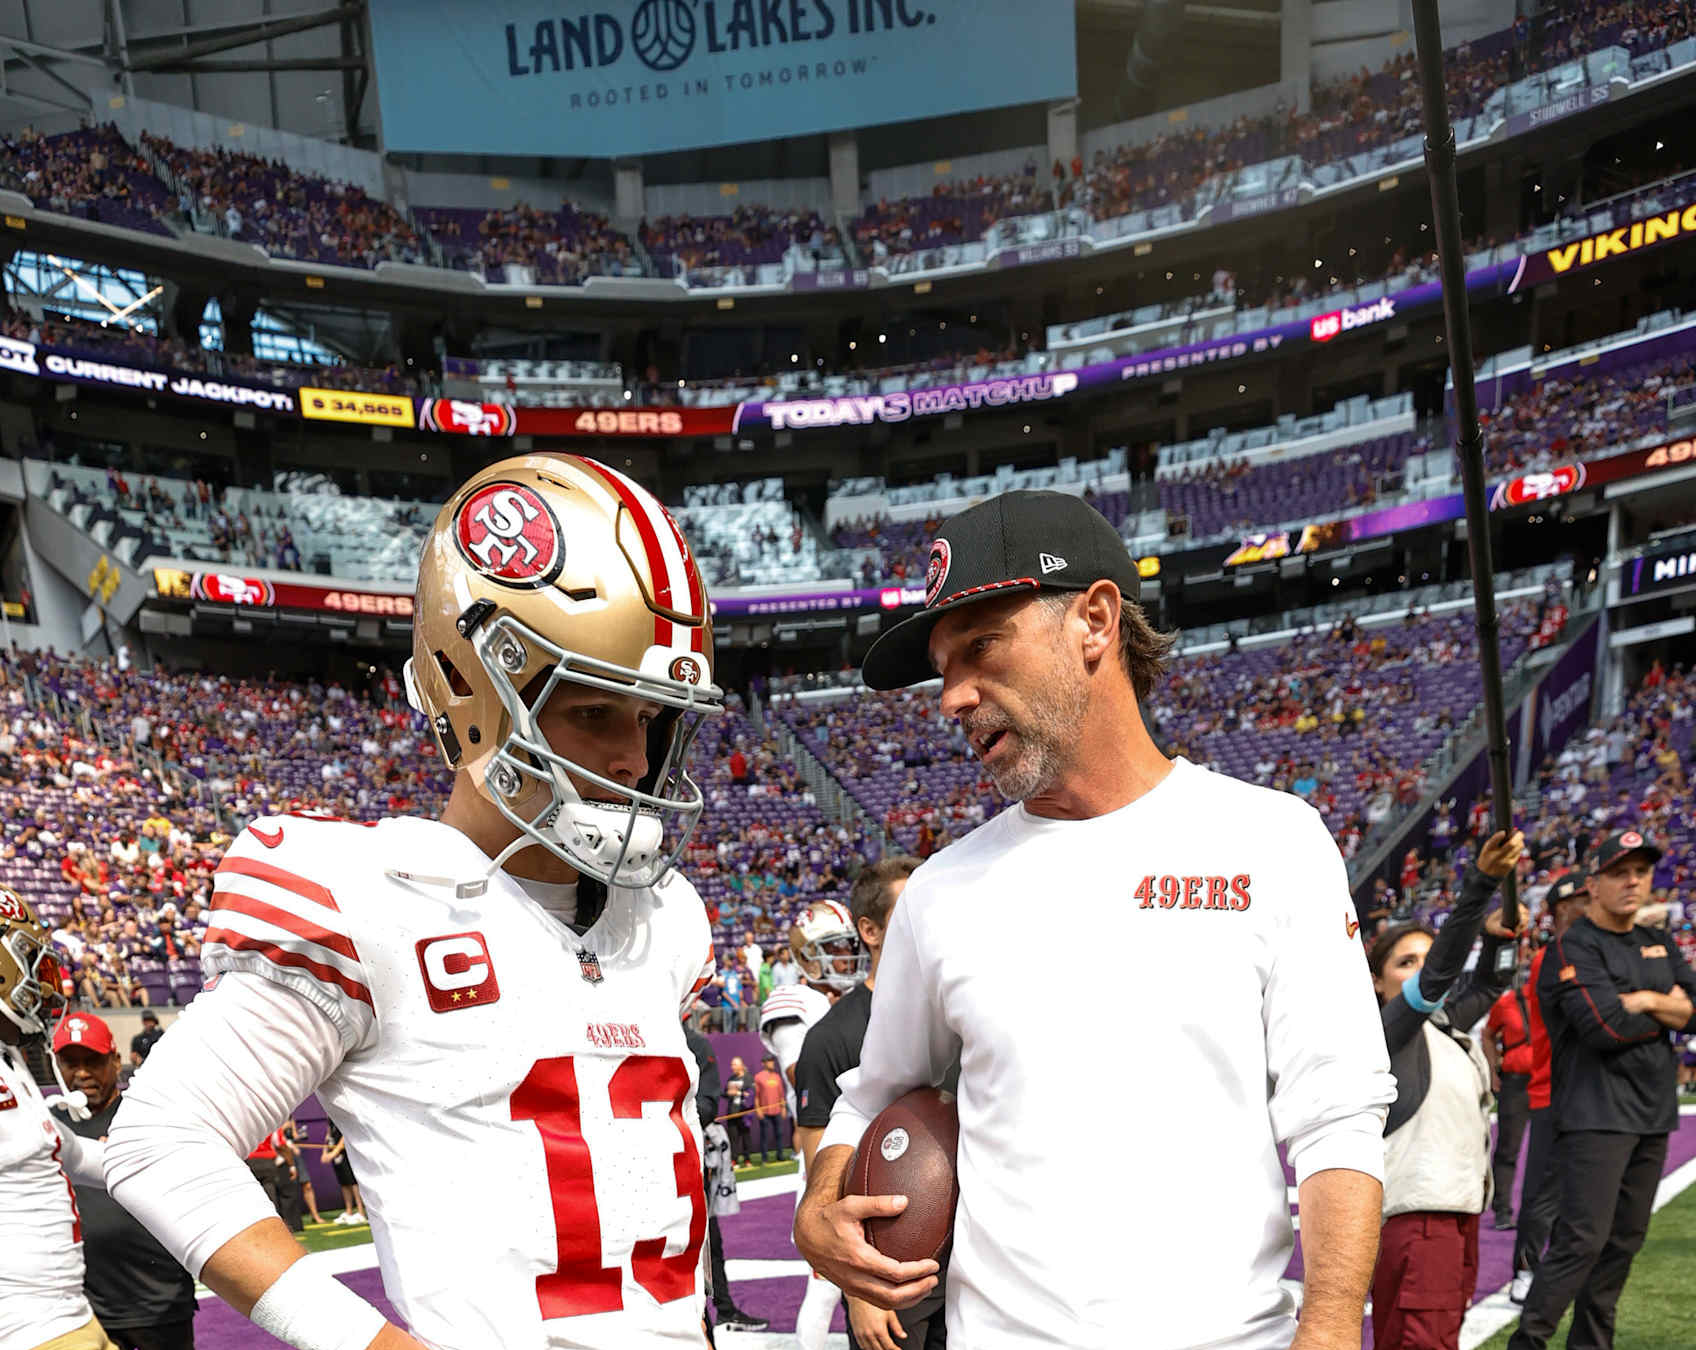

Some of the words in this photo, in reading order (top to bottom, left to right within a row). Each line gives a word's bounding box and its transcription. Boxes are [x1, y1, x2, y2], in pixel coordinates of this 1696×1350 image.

[504, 14, 624, 76] LAND
[848, 0, 936, 34] INC.
[569, 84, 669, 110] ROOTED
[683, 78, 709, 97] IN
[724, 59, 869, 91] TOMORROW
[1341, 296, 1397, 331] bank
[45, 354, 168, 392] CURRENT
[1121, 341, 1248, 381] PRESENTED
[1253, 334, 1283, 353] BY
[911, 373, 1079, 417] MATCHUP
[574, 411, 684, 434] 49ERS
[1644, 439, 1696, 468] 49
[324, 591, 414, 616] 49ERS
[1132, 873, 1252, 912] 49ERS
[424, 936, 490, 992] C
[586, 1022, 647, 1048] 49ERS
[508, 1055, 708, 1321] 13
